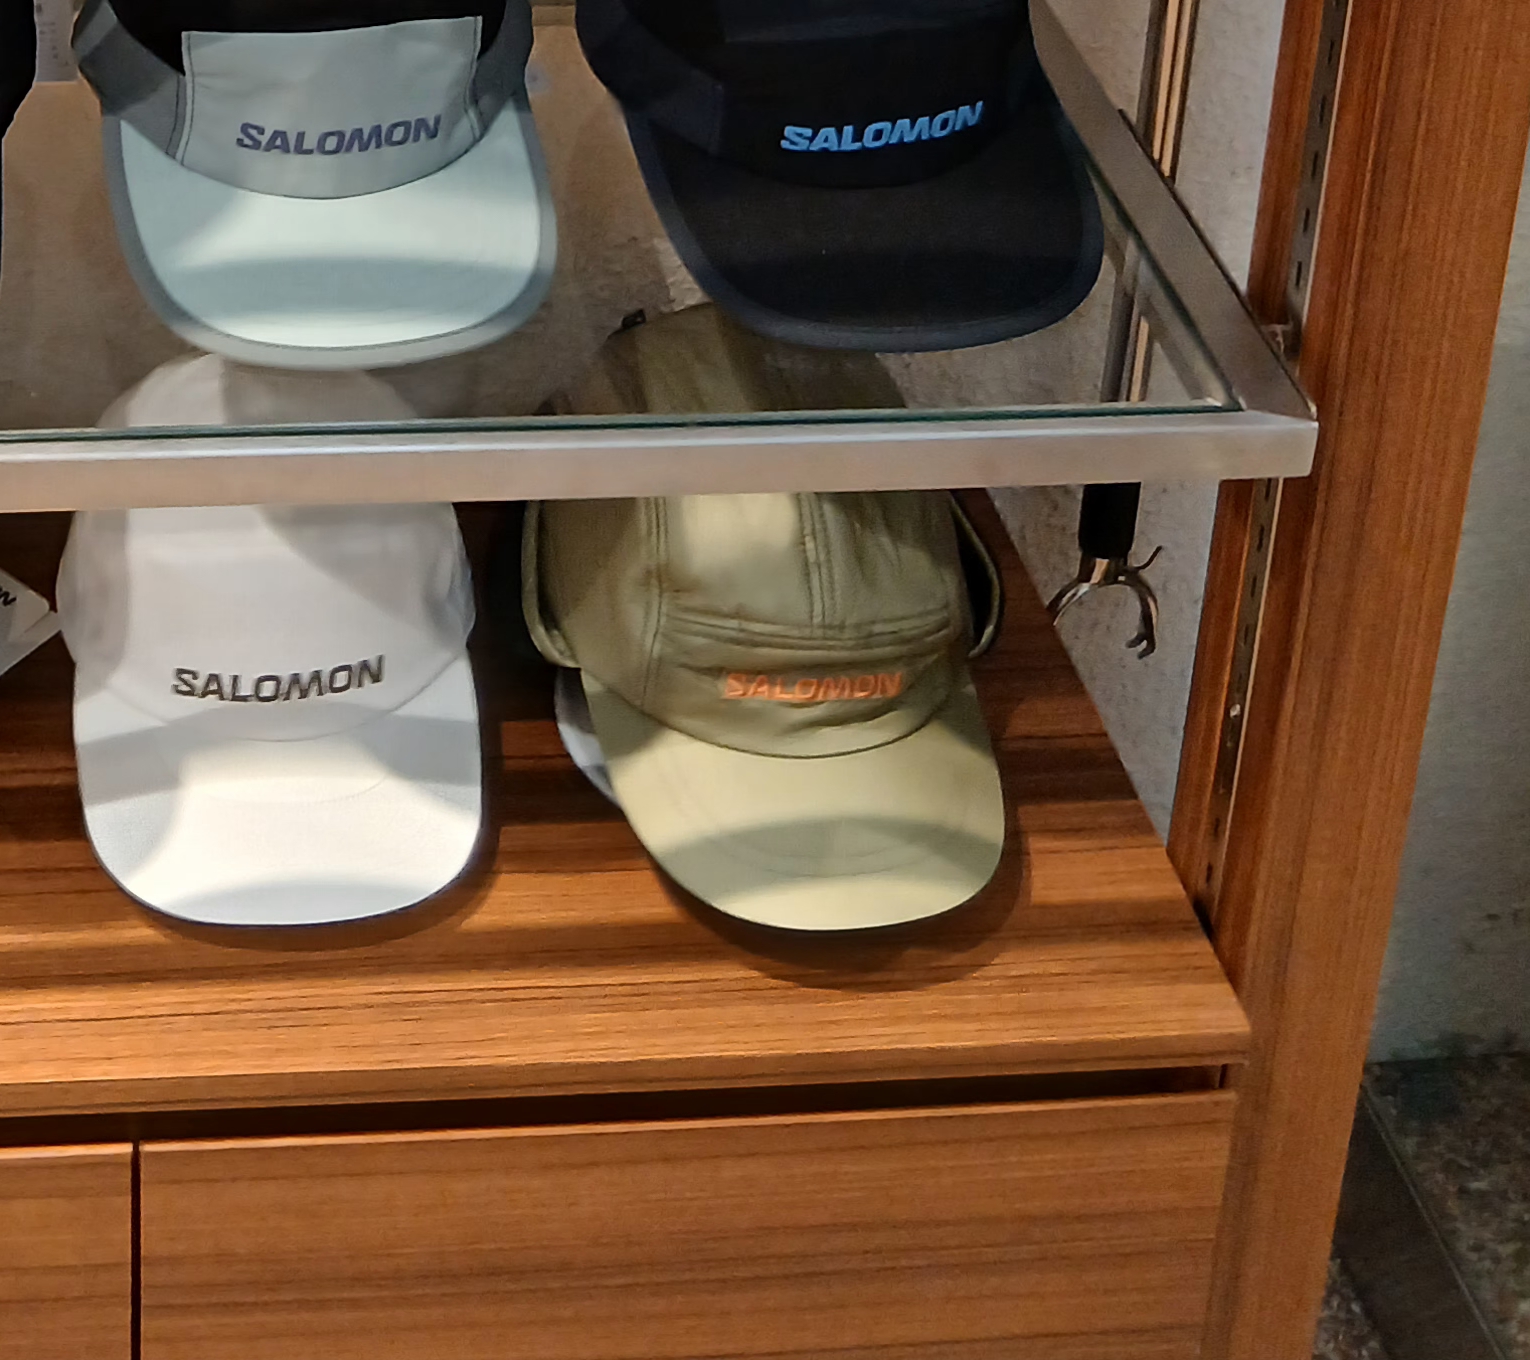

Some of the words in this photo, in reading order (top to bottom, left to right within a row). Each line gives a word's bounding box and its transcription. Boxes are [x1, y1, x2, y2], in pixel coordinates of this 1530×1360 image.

[235, 113, 442, 157] SALOMON
[781, 100, 984, 153] SALOMON
[172, 654, 386, 704] SALOMON
[724, 672, 903, 700] SALOMON
